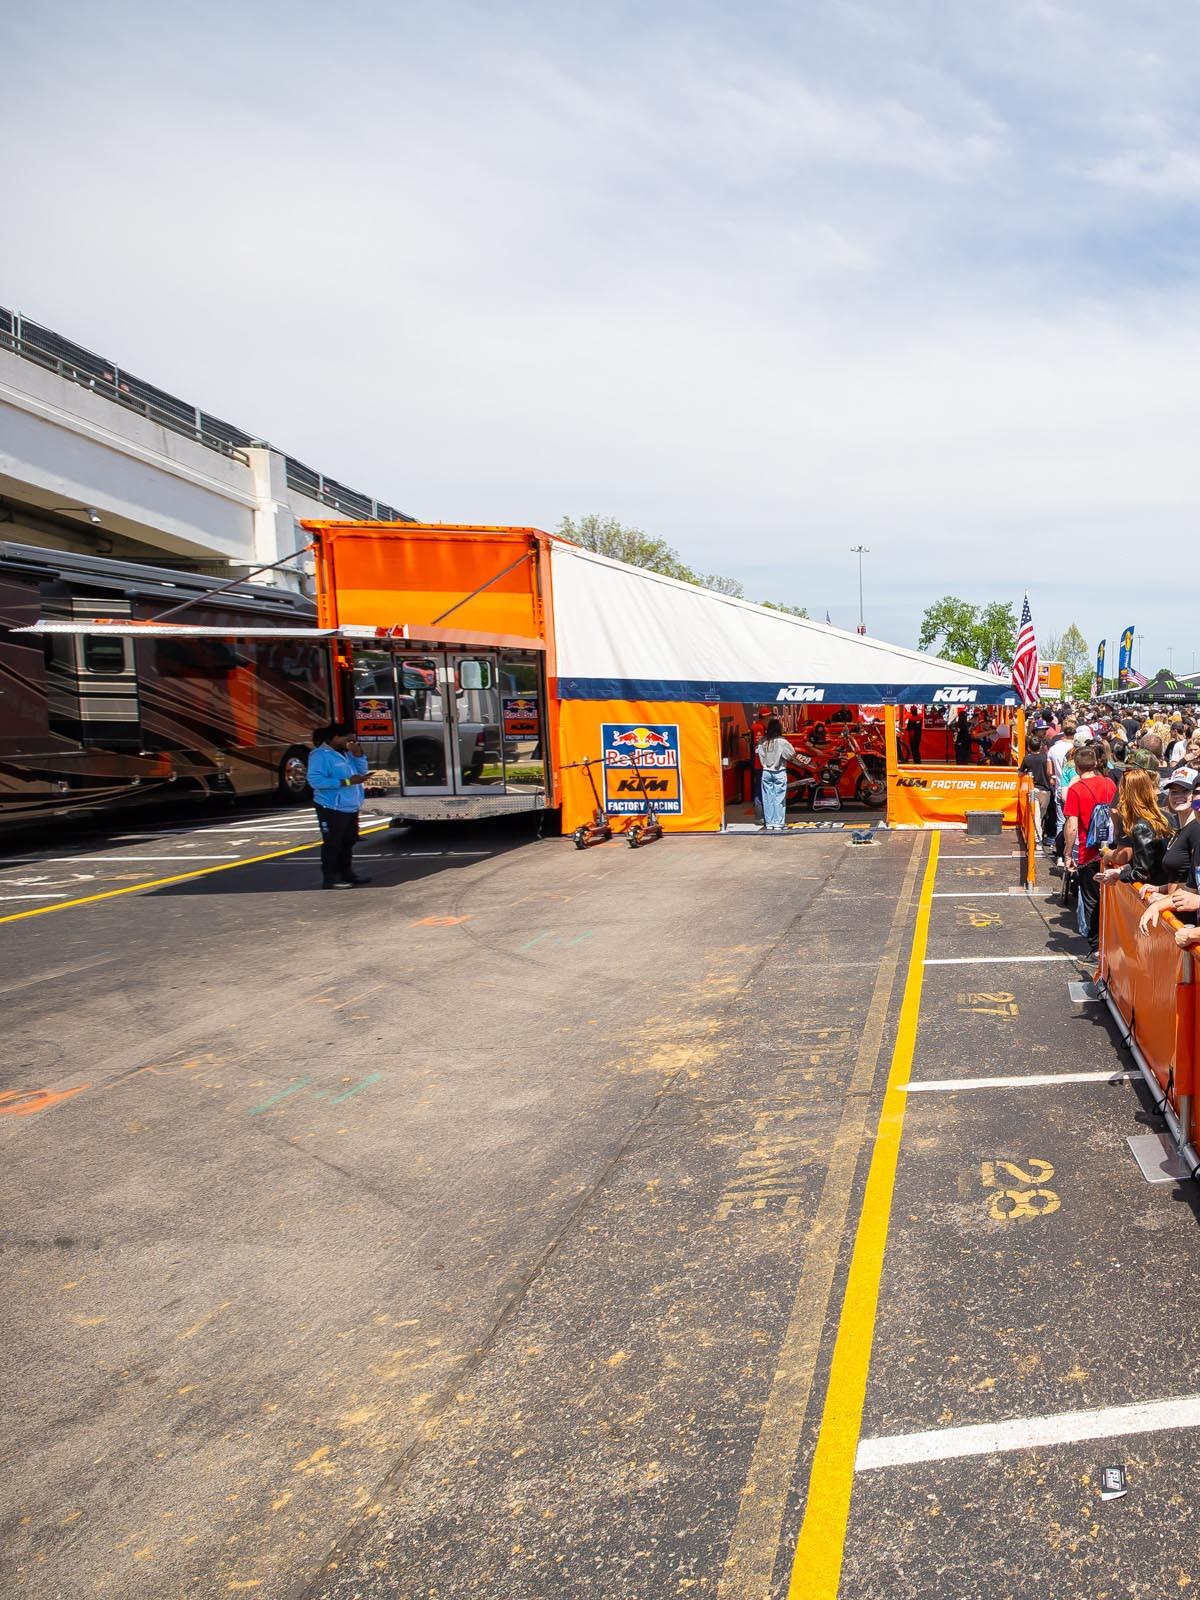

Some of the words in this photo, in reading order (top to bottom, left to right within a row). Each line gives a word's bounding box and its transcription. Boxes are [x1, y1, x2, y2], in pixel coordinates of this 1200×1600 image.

[776, 685, 825, 701] KTM
[933, 687, 977, 702] KTM
[605, 749, 641, 766] Red
[643, 749, 677, 766] Bull
[617, 776, 669, 792] KTM
[980, 781, 1017, 790] RACING
[608, 801, 645, 810] FACTORY
[981, 1158, 1062, 1220] 28
